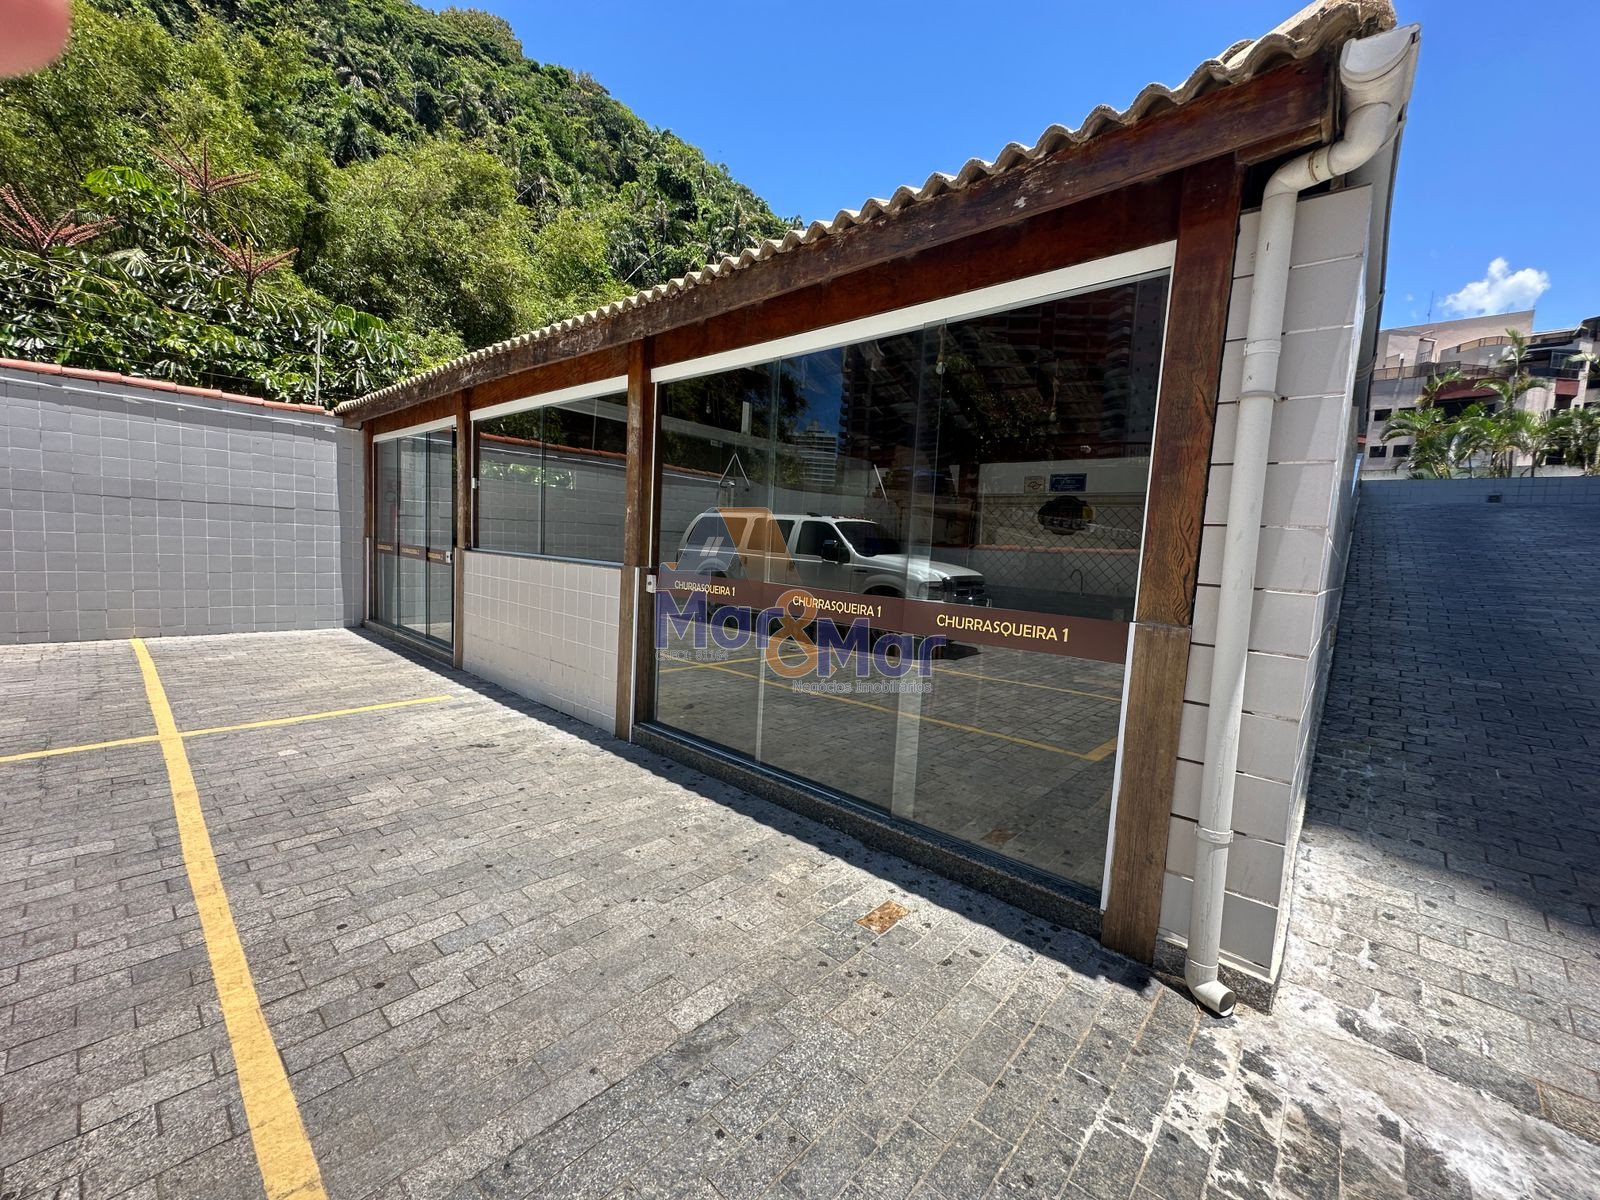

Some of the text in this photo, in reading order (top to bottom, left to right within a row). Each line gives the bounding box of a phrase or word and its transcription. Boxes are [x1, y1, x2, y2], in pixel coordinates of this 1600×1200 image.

[674, 580, 736, 597] CHURRASQUEIRA 1
[792, 595, 882, 618] CHURRASQUEIRA 1
[936, 614, 1069, 642] CHURRASQUEIRA 1
